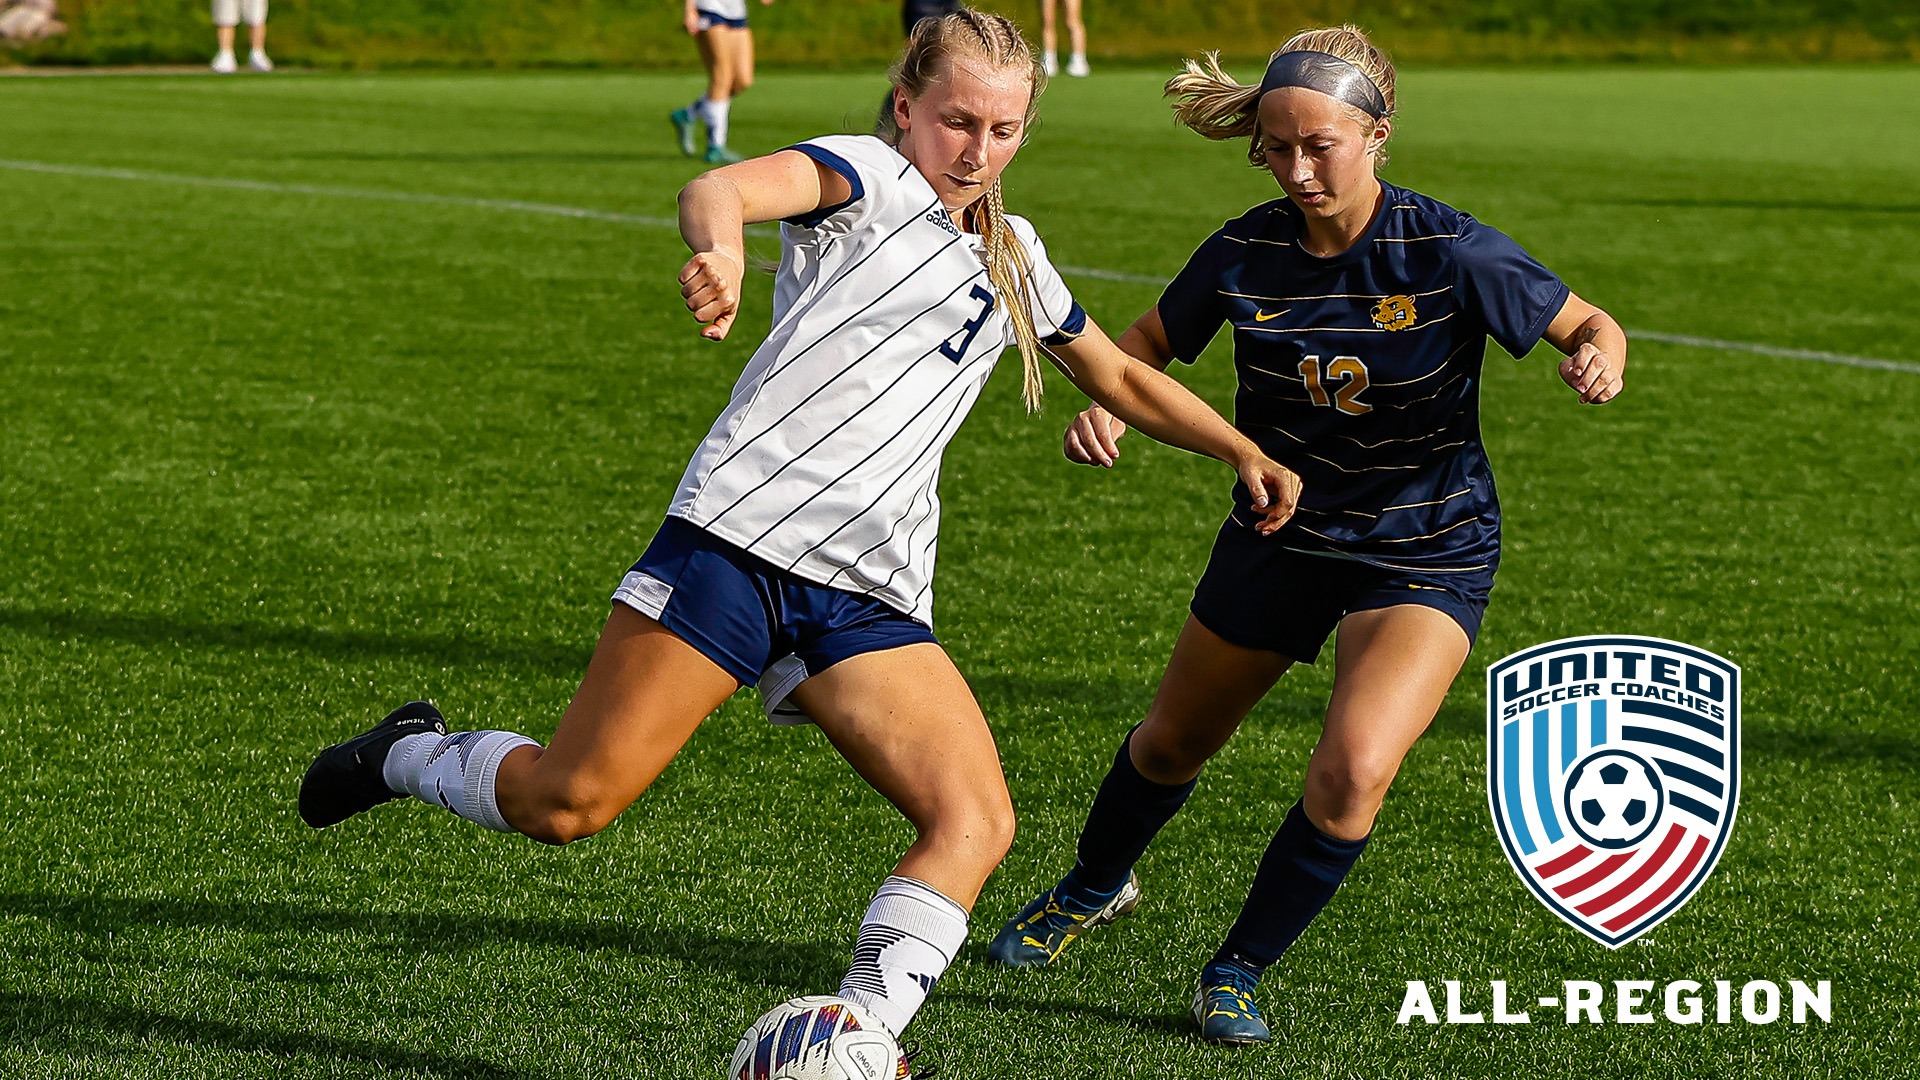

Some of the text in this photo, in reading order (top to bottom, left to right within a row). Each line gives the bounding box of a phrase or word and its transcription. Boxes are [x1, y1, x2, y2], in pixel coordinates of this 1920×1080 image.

[925, 213, 960, 237] adidas
[938, 283, 995, 366] 3
[1298, 354, 1373, 416] 12
